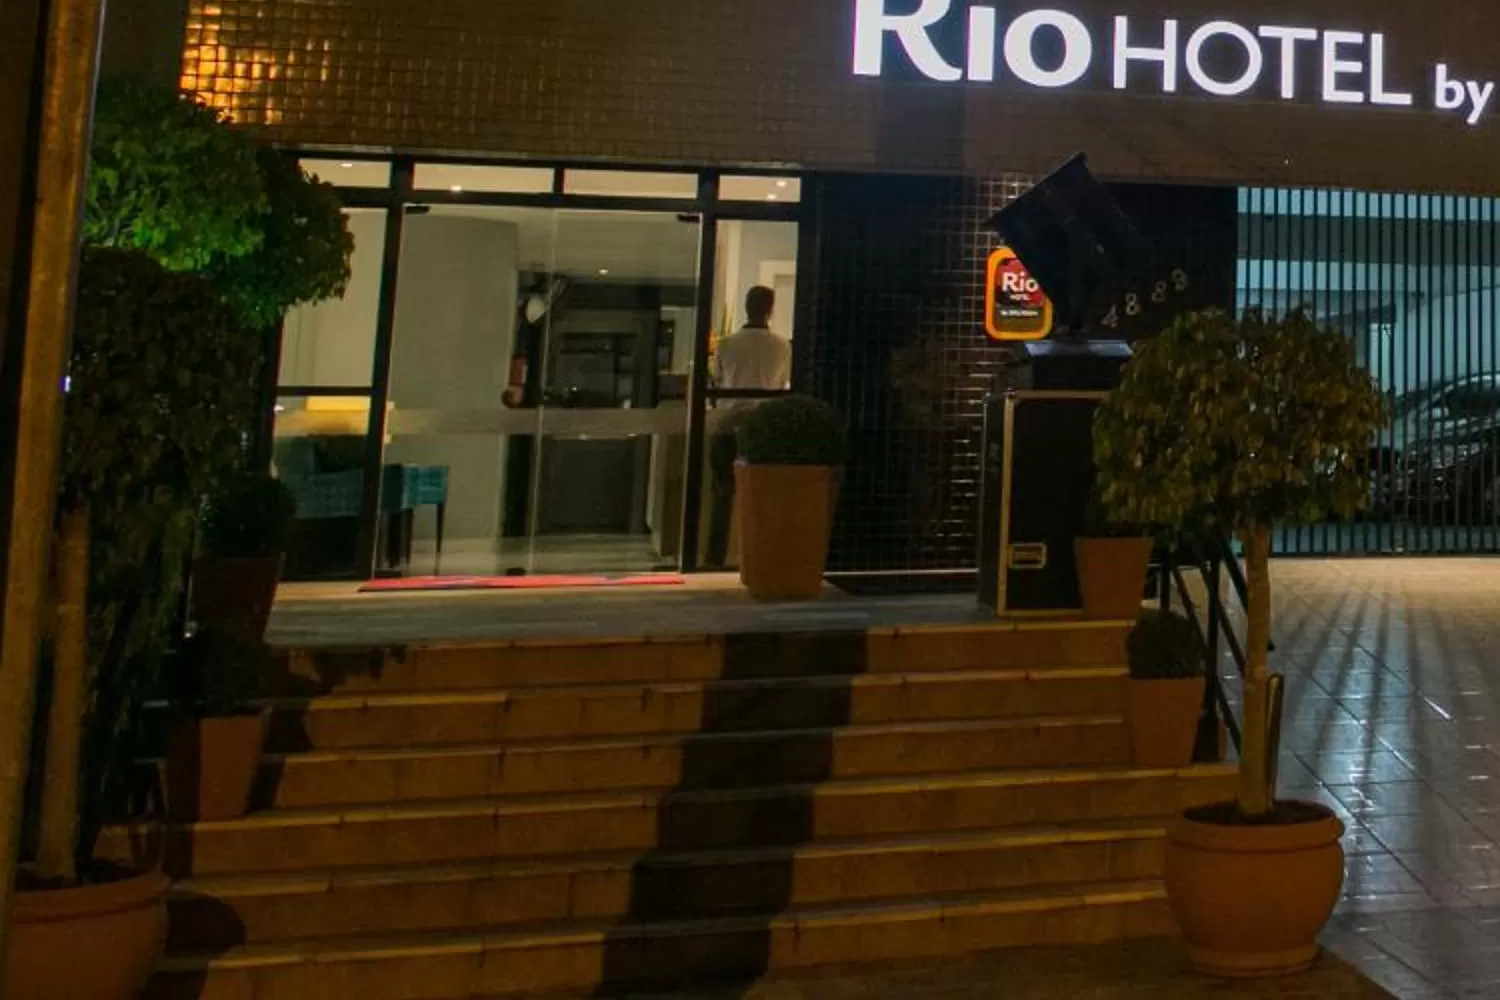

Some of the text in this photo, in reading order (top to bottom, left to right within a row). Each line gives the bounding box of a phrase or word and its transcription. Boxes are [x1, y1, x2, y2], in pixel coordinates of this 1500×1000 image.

[1113, 15, 1413, 106] HOTEL
[1434, 63, 1495, 125] by
[1001, 271, 1040, 293] Rio
